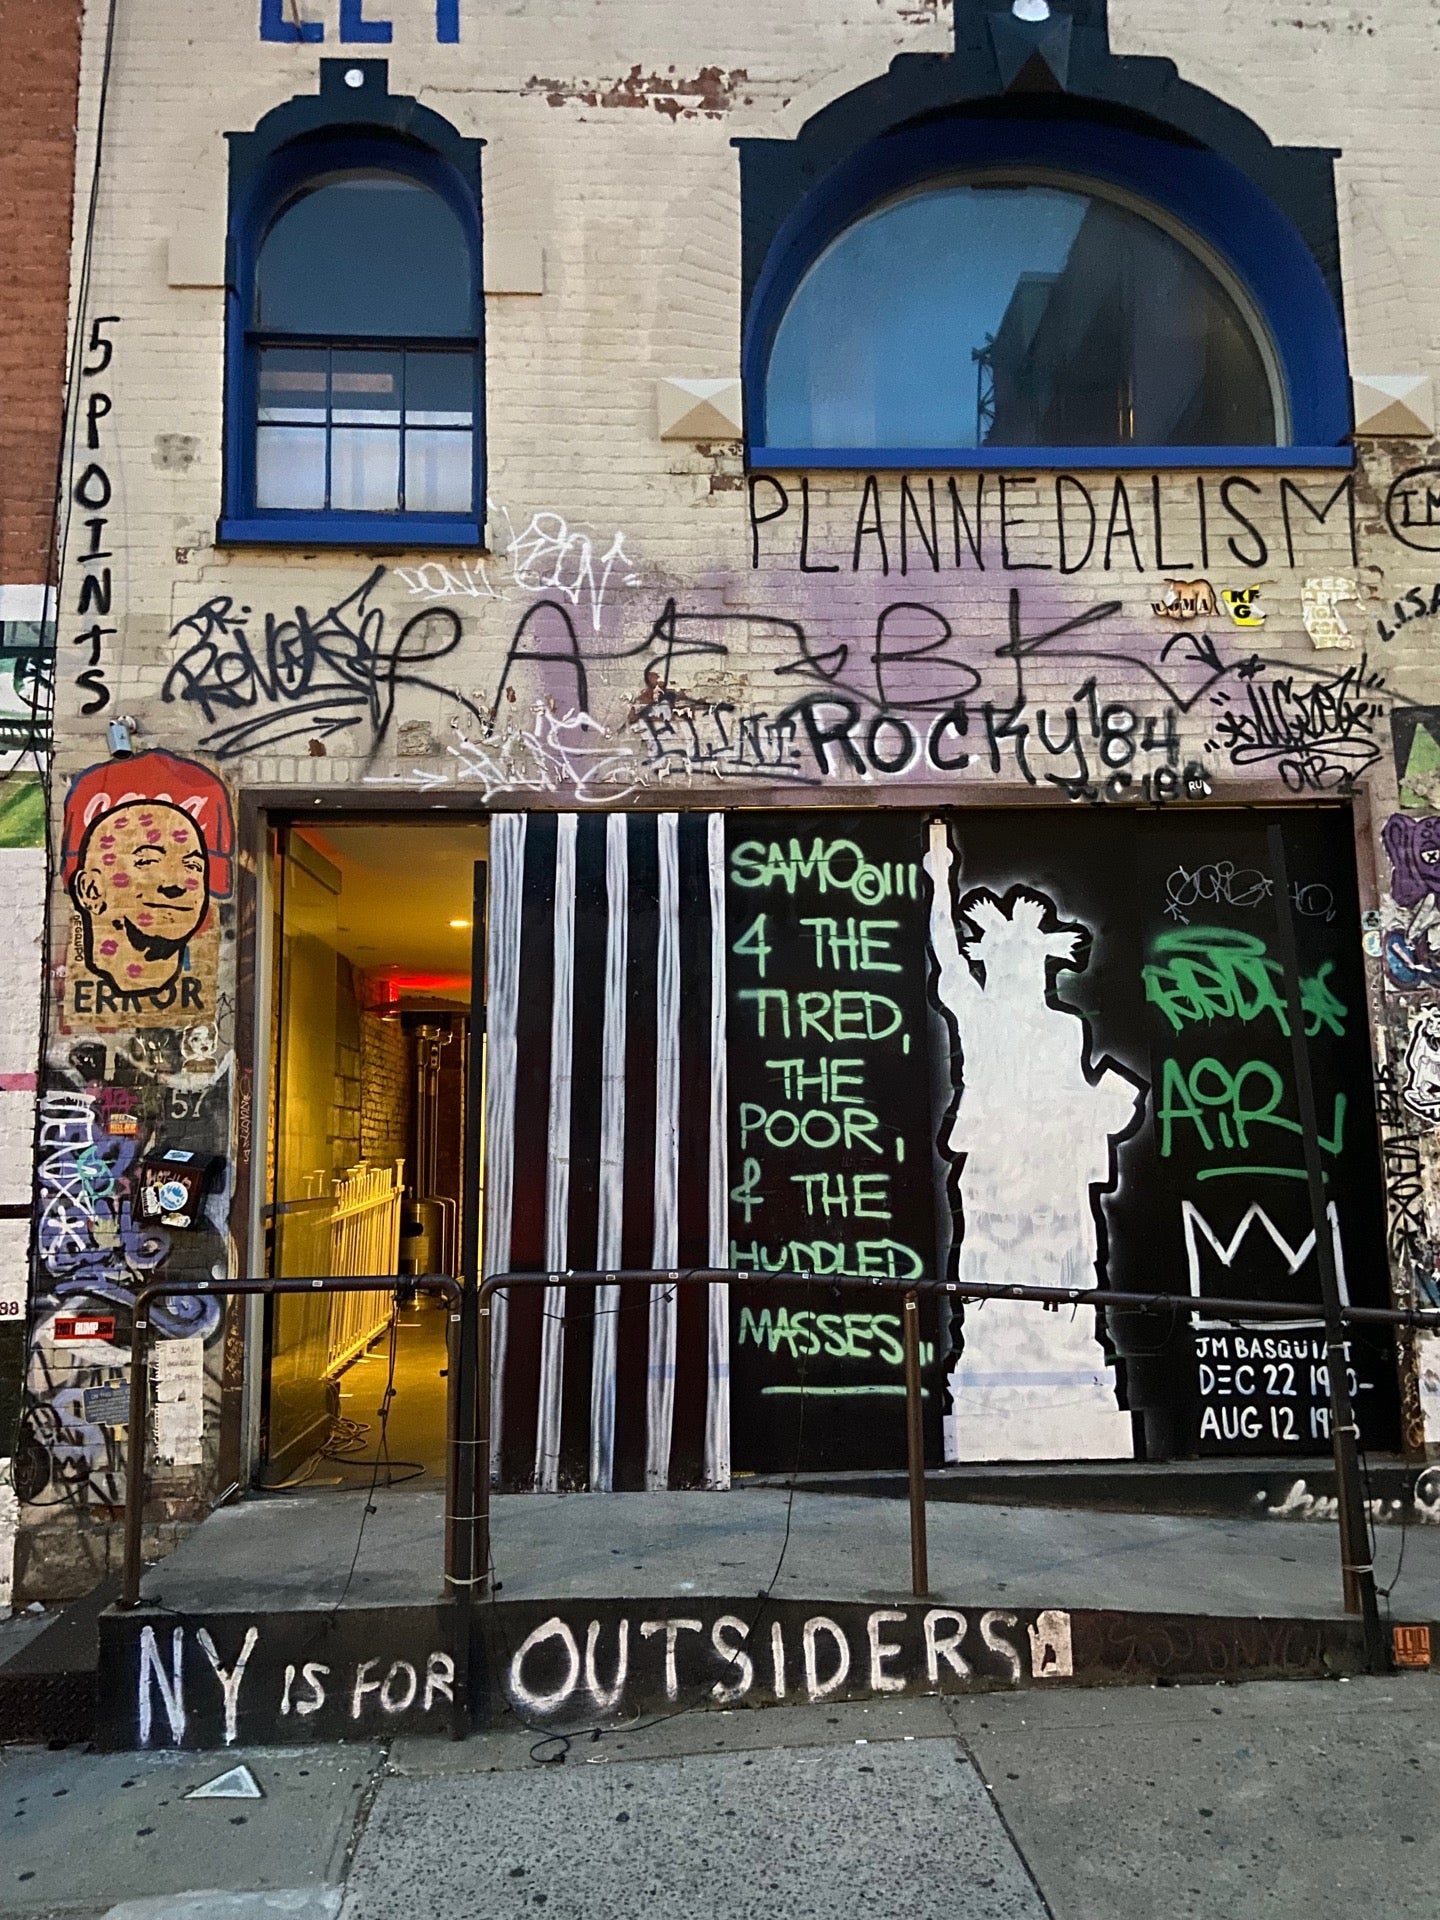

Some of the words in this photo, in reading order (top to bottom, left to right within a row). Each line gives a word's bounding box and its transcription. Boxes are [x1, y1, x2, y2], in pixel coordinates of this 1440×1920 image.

[748, 474, 1359, 578] PLANNEDALISM
[73, 392, 118, 715] POINTS
[732, 912, 773, 978] 4
[799, 917, 903, 972] THE
[765, 1056, 866, 1103] THE
[170, 1088, 209, 1119] 57
[790, 1172, 893, 1218] THE
[730, 1239, 924, 1279] HUDDLED
[1195, 1337, 1228, 1358] JM
[1199, 1365, 1256, 1396] DEC
[1263, 1363, 1298, 1396] 22
[1200, 1405, 1263, 1440] AUG
[1270, 1405, 1300, 1440] 12
[139, 1625, 259, 1747] NY
[280, 1663, 331, 1716] IS
[351, 1652, 455, 1719] FOR
[510, 1609, 1022, 1713] OUTSIDERS
